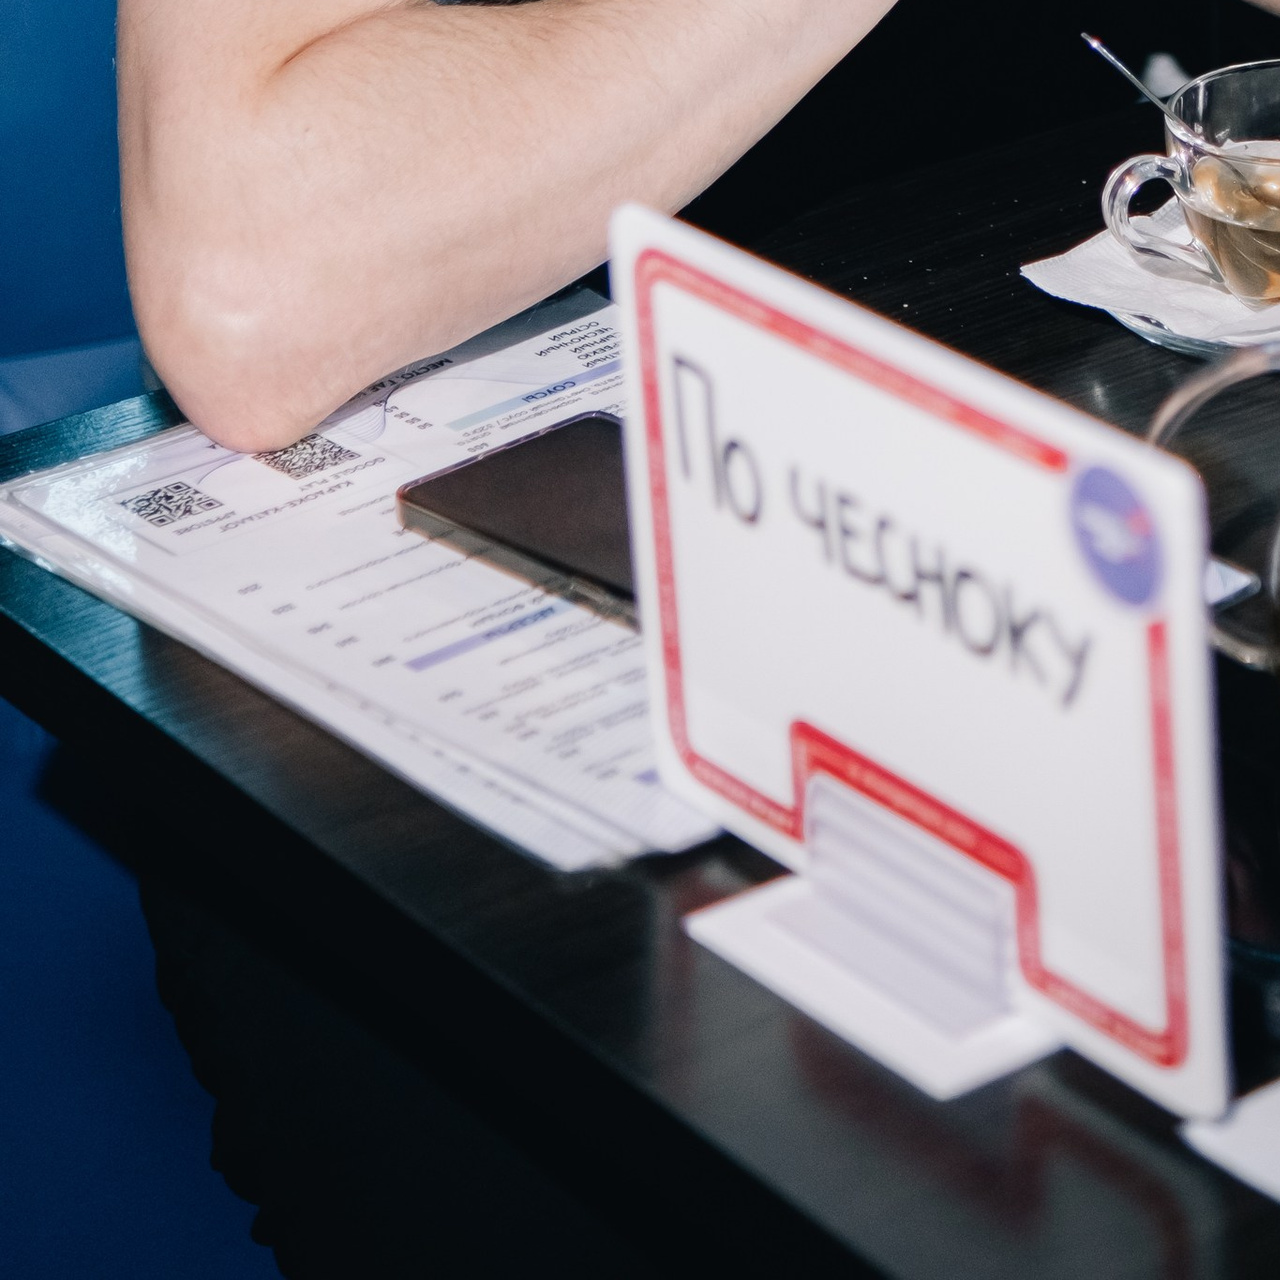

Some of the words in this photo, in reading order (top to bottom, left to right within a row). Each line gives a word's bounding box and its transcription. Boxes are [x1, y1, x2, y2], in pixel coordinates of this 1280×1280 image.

[535, 327, 613, 357] ЧЕСНОЧНЫЙ
[550, 321, 600, 341] ОСТРЫЙ
[521, 381, 576, 403] СОУСЫ
[332, 457, 386, 481] GOOGLE
